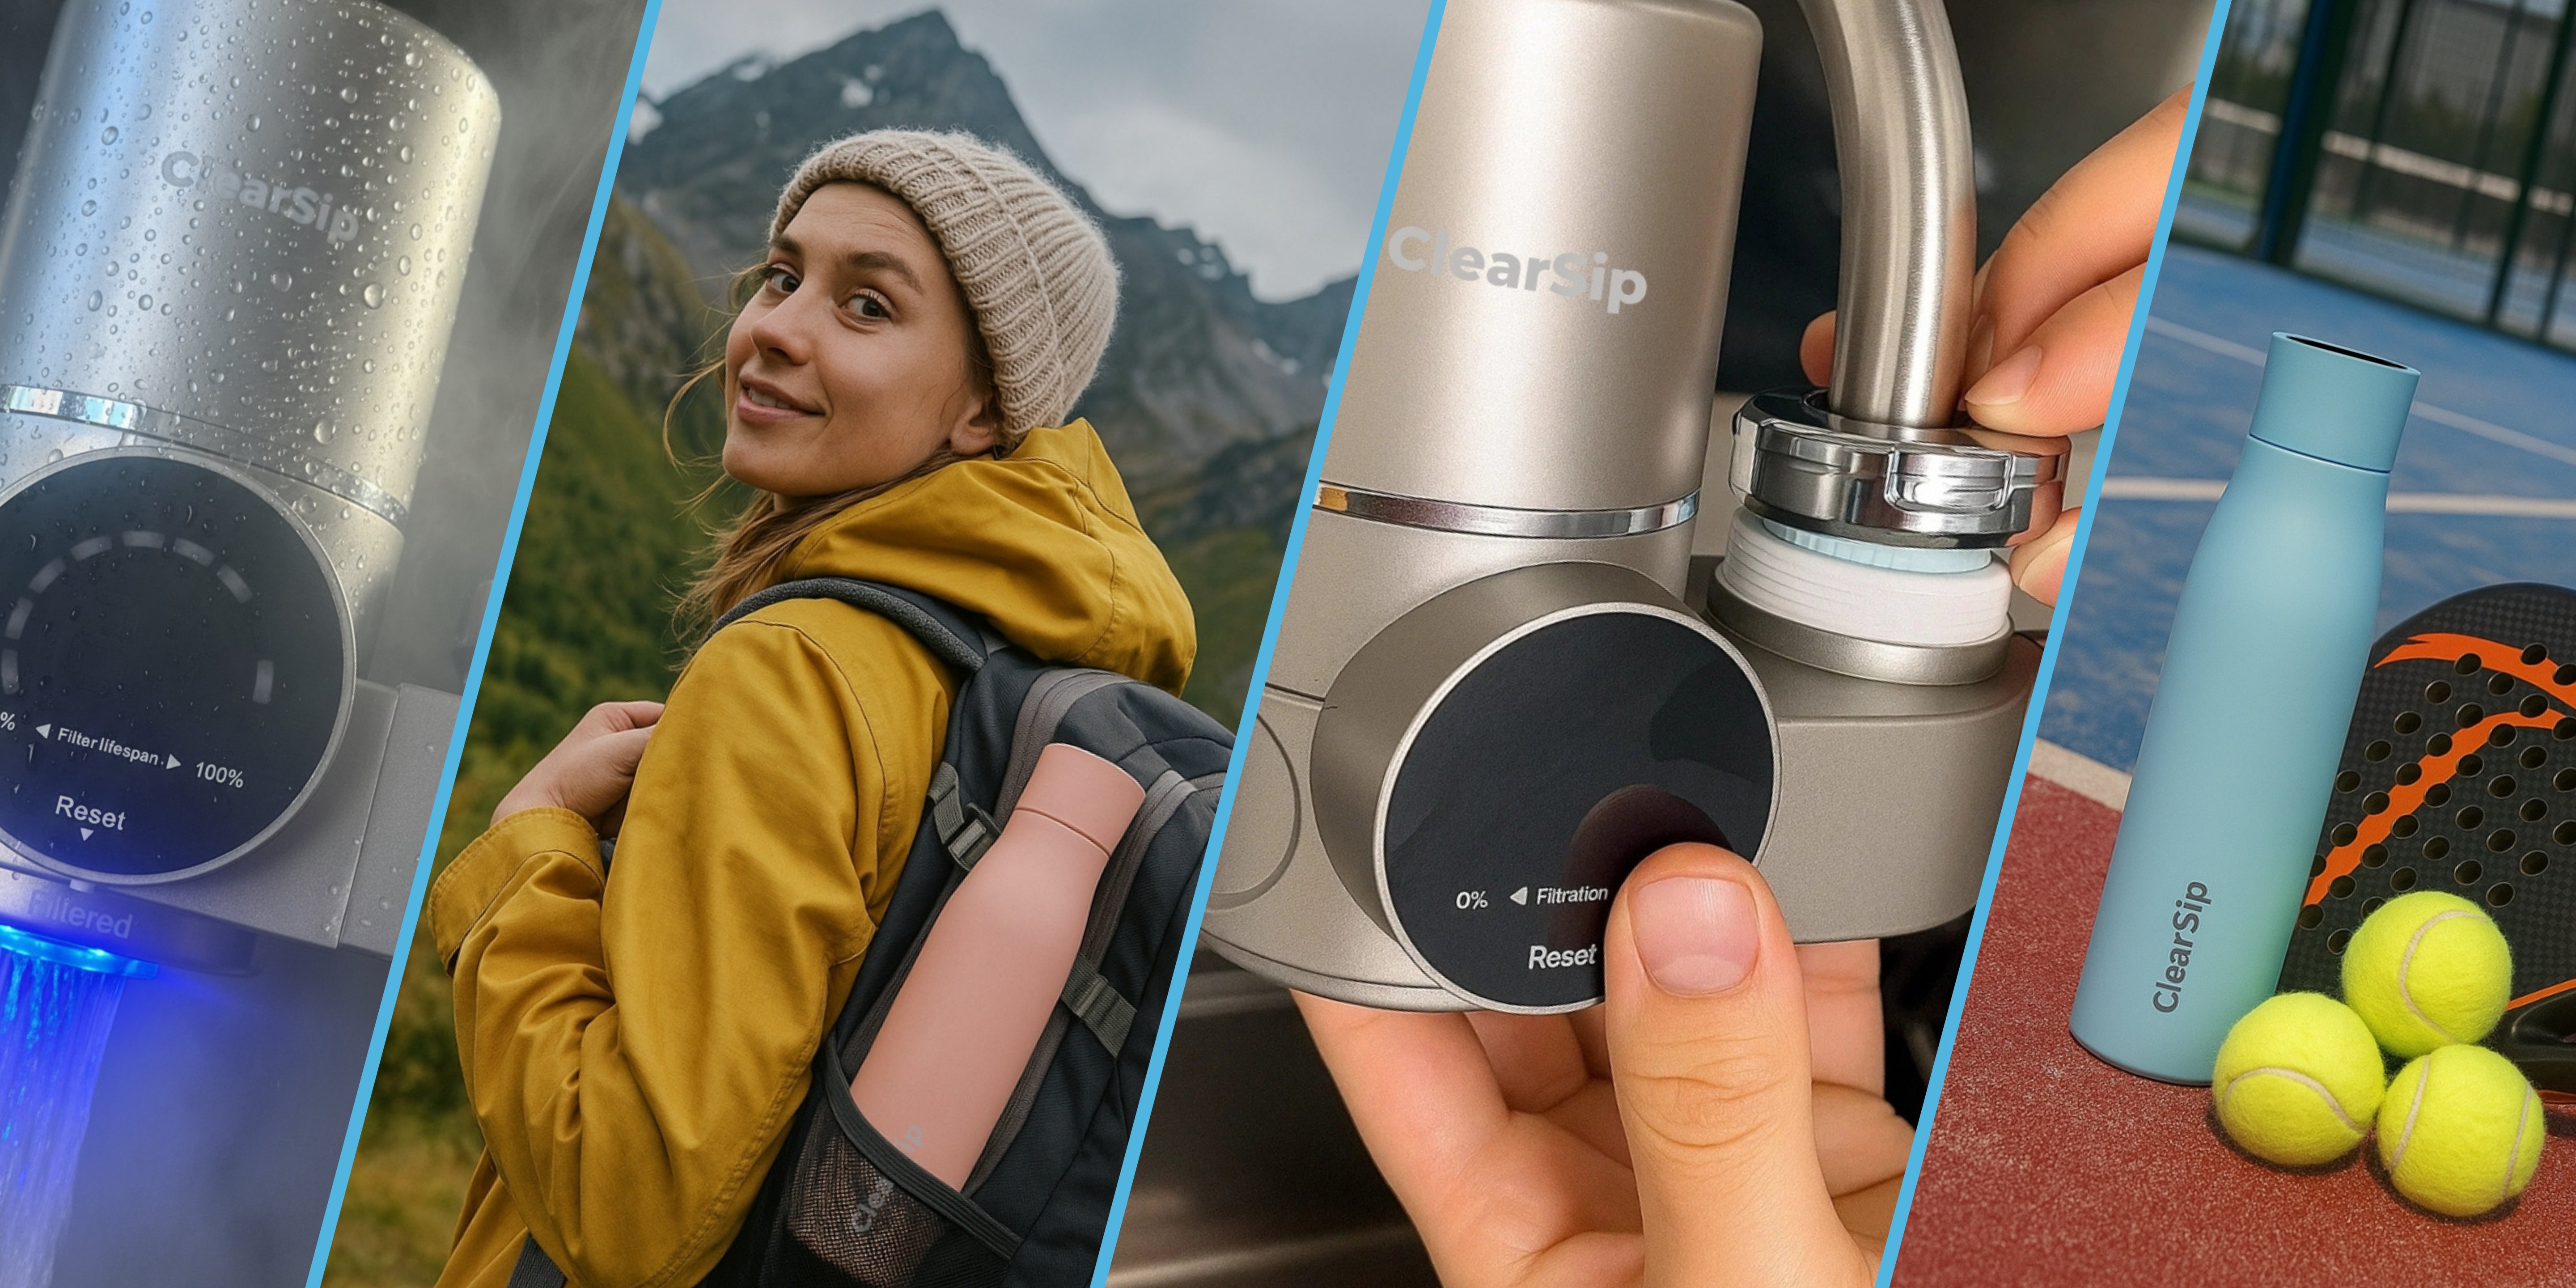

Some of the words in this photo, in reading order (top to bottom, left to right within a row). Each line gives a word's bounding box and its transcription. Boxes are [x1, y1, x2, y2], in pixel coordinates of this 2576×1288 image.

[161, 151, 359, 244] ClearSip
[1388, 226, 1648, 314] ClearSip
[57, 727, 98, 749] Filter
[99, 737, 159, 765] lifespan
[196, 762, 243, 788] 100%
[55, 795, 126, 830] Reset
[28, 889, 133, 939] Filtered
[1456, 890, 1488, 910] 0%
[1537, 885, 1609, 905] Filtration
[1528, 944, 1597, 970] Reset
[2152, 881, 2212, 1013] ClearSip
[852, 1125, 923, 1233] Cleaip
